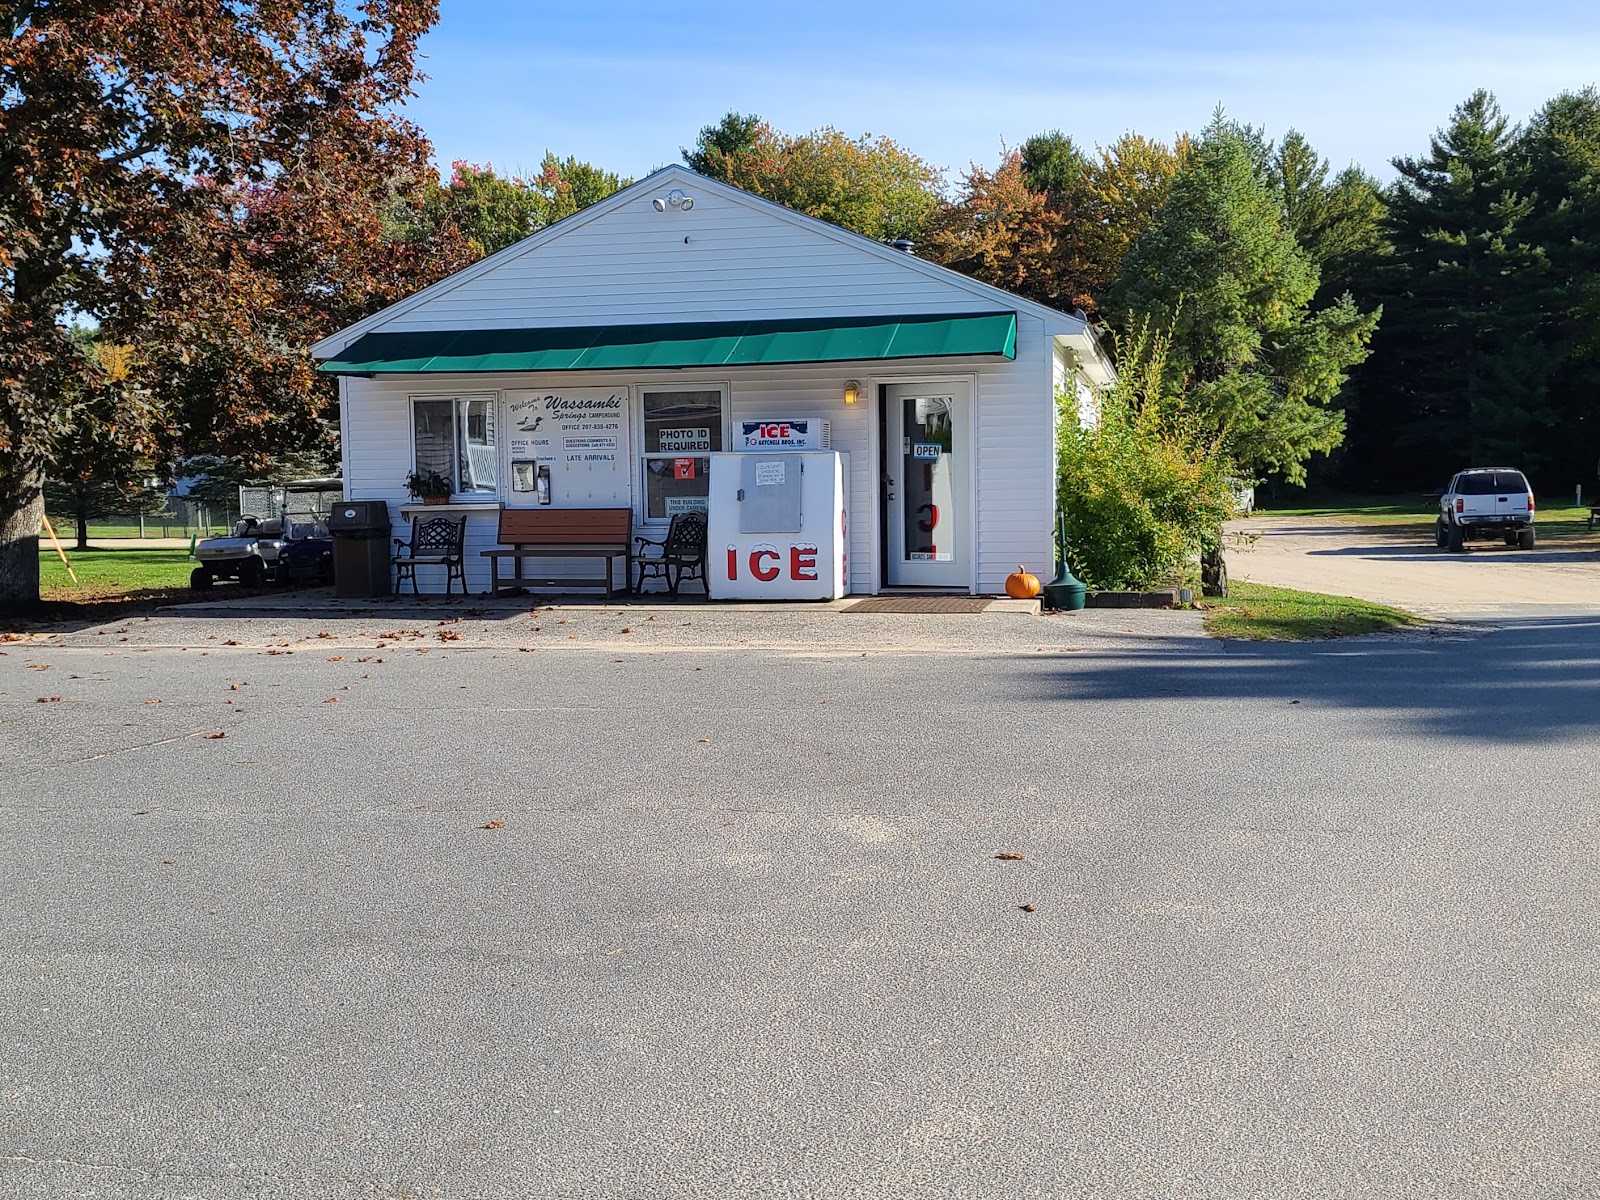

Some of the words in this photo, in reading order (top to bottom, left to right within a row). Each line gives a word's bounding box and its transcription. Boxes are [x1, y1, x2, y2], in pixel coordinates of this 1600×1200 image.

[510, 396, 541, 412] Welcome
[528, 404, 538, 412] To
[544, 395, 621, 410] Wassamki
[552, 410, 586, 421] Springs
[660, 430, 694, 439] PHOTO
[697, 429, 707, 438] ID
[760, 424, 790, 439] ICE
[660, 441, 709, 451] REQUIRED
[916, 445, 940, 456] OPEN
[566, 454, 582, 462] LATE
[584, 453, 615, 461] ARRIVALS
[727, 543, 818, 582] ICE
